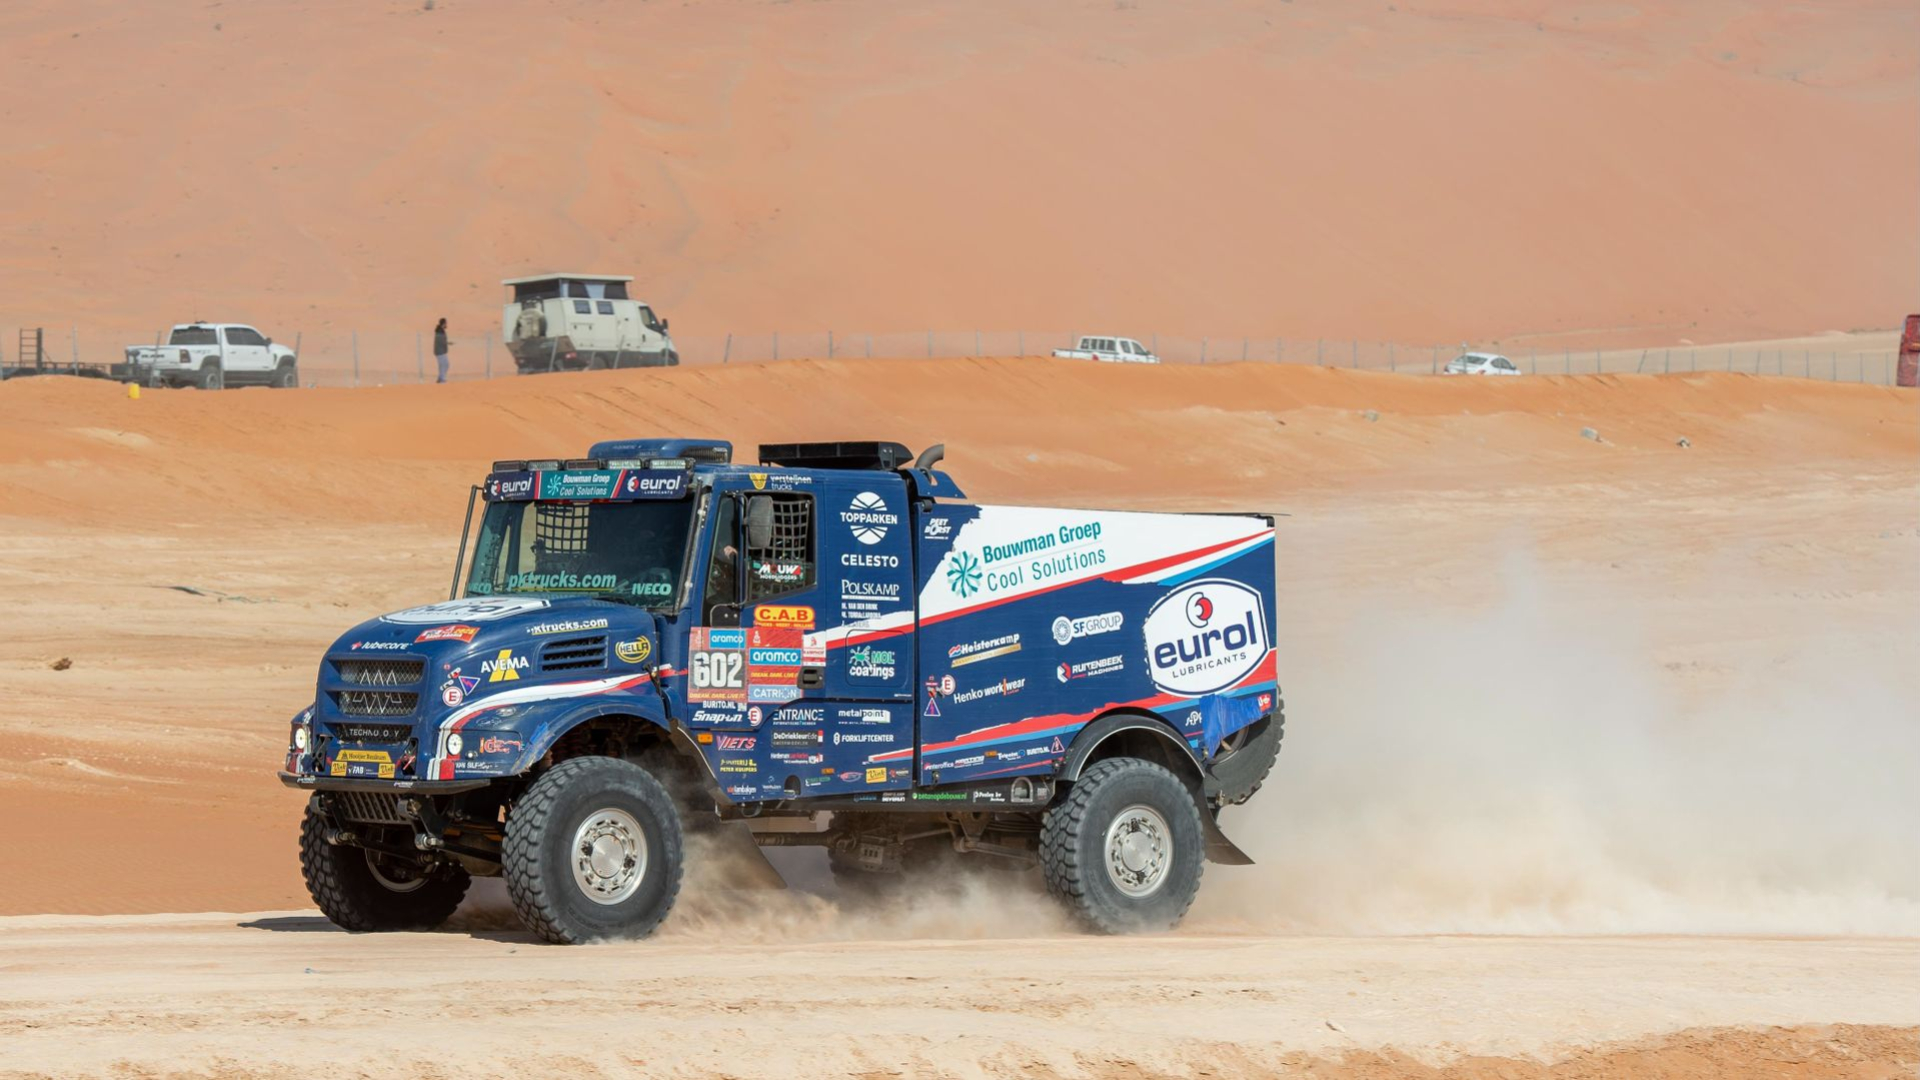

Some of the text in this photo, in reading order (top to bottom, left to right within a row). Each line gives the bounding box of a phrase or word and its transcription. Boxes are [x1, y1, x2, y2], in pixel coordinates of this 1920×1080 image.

[502, 476, 533, 493] eurol
[562, 474, 610, 484] Bouwman Groep
[640, 475, 682, 490] eurol
[559, 486, 607, 496] Cool Solutions
[771, 483, 793, 491] trucks
[840, 512, 898, 525] TOPPARKEN
[982, 521, 1102, 564] Bouwman Groep
[841, 554, 899, 567] CELESTO
[987, 549, 1106, 592] Cool Solutions
[508, 570, 617, 590] pktrucks.com
[631, 583, 672, 595] IVECO
[842, 579, 900, 596] POLSKAMP
[759, 608, 808, 621] C.A.B
[1073, 613, 1121, 633] SFGROUP
[711, 634, 744, 643] aramco
[961, 633, 1020, 654] Heisterkamp
[1154, 611, 1257, 669] eurol
[361, 641, 409, 650] lubecore
[619, 640, 649, 652] HELLA
[752, 651, 798, 662] aramco
[871, 651, 895, 664] MOL
[480, 656, 529, 673] AVEMA
[693, 652, 742, 687] 602
[1072, 656, 1123, 673] RUITENBEEK
[1088, 664, 1124, 677] MACHINES
[1172, 652, 1247, 678] LUBRICANTS
[849, 664, 895, 679] coatings
[953, 688, 983, 703] Henko
[702, 700, 736, 709] BURITO.NL
[692, 711, 742, 724] Snap-on
[773, 709, 824, 721] ENTRANCE
[716, 736, 756, 751] VIETS
[841, 734, 894, 742] FORKLIFTCENTER
